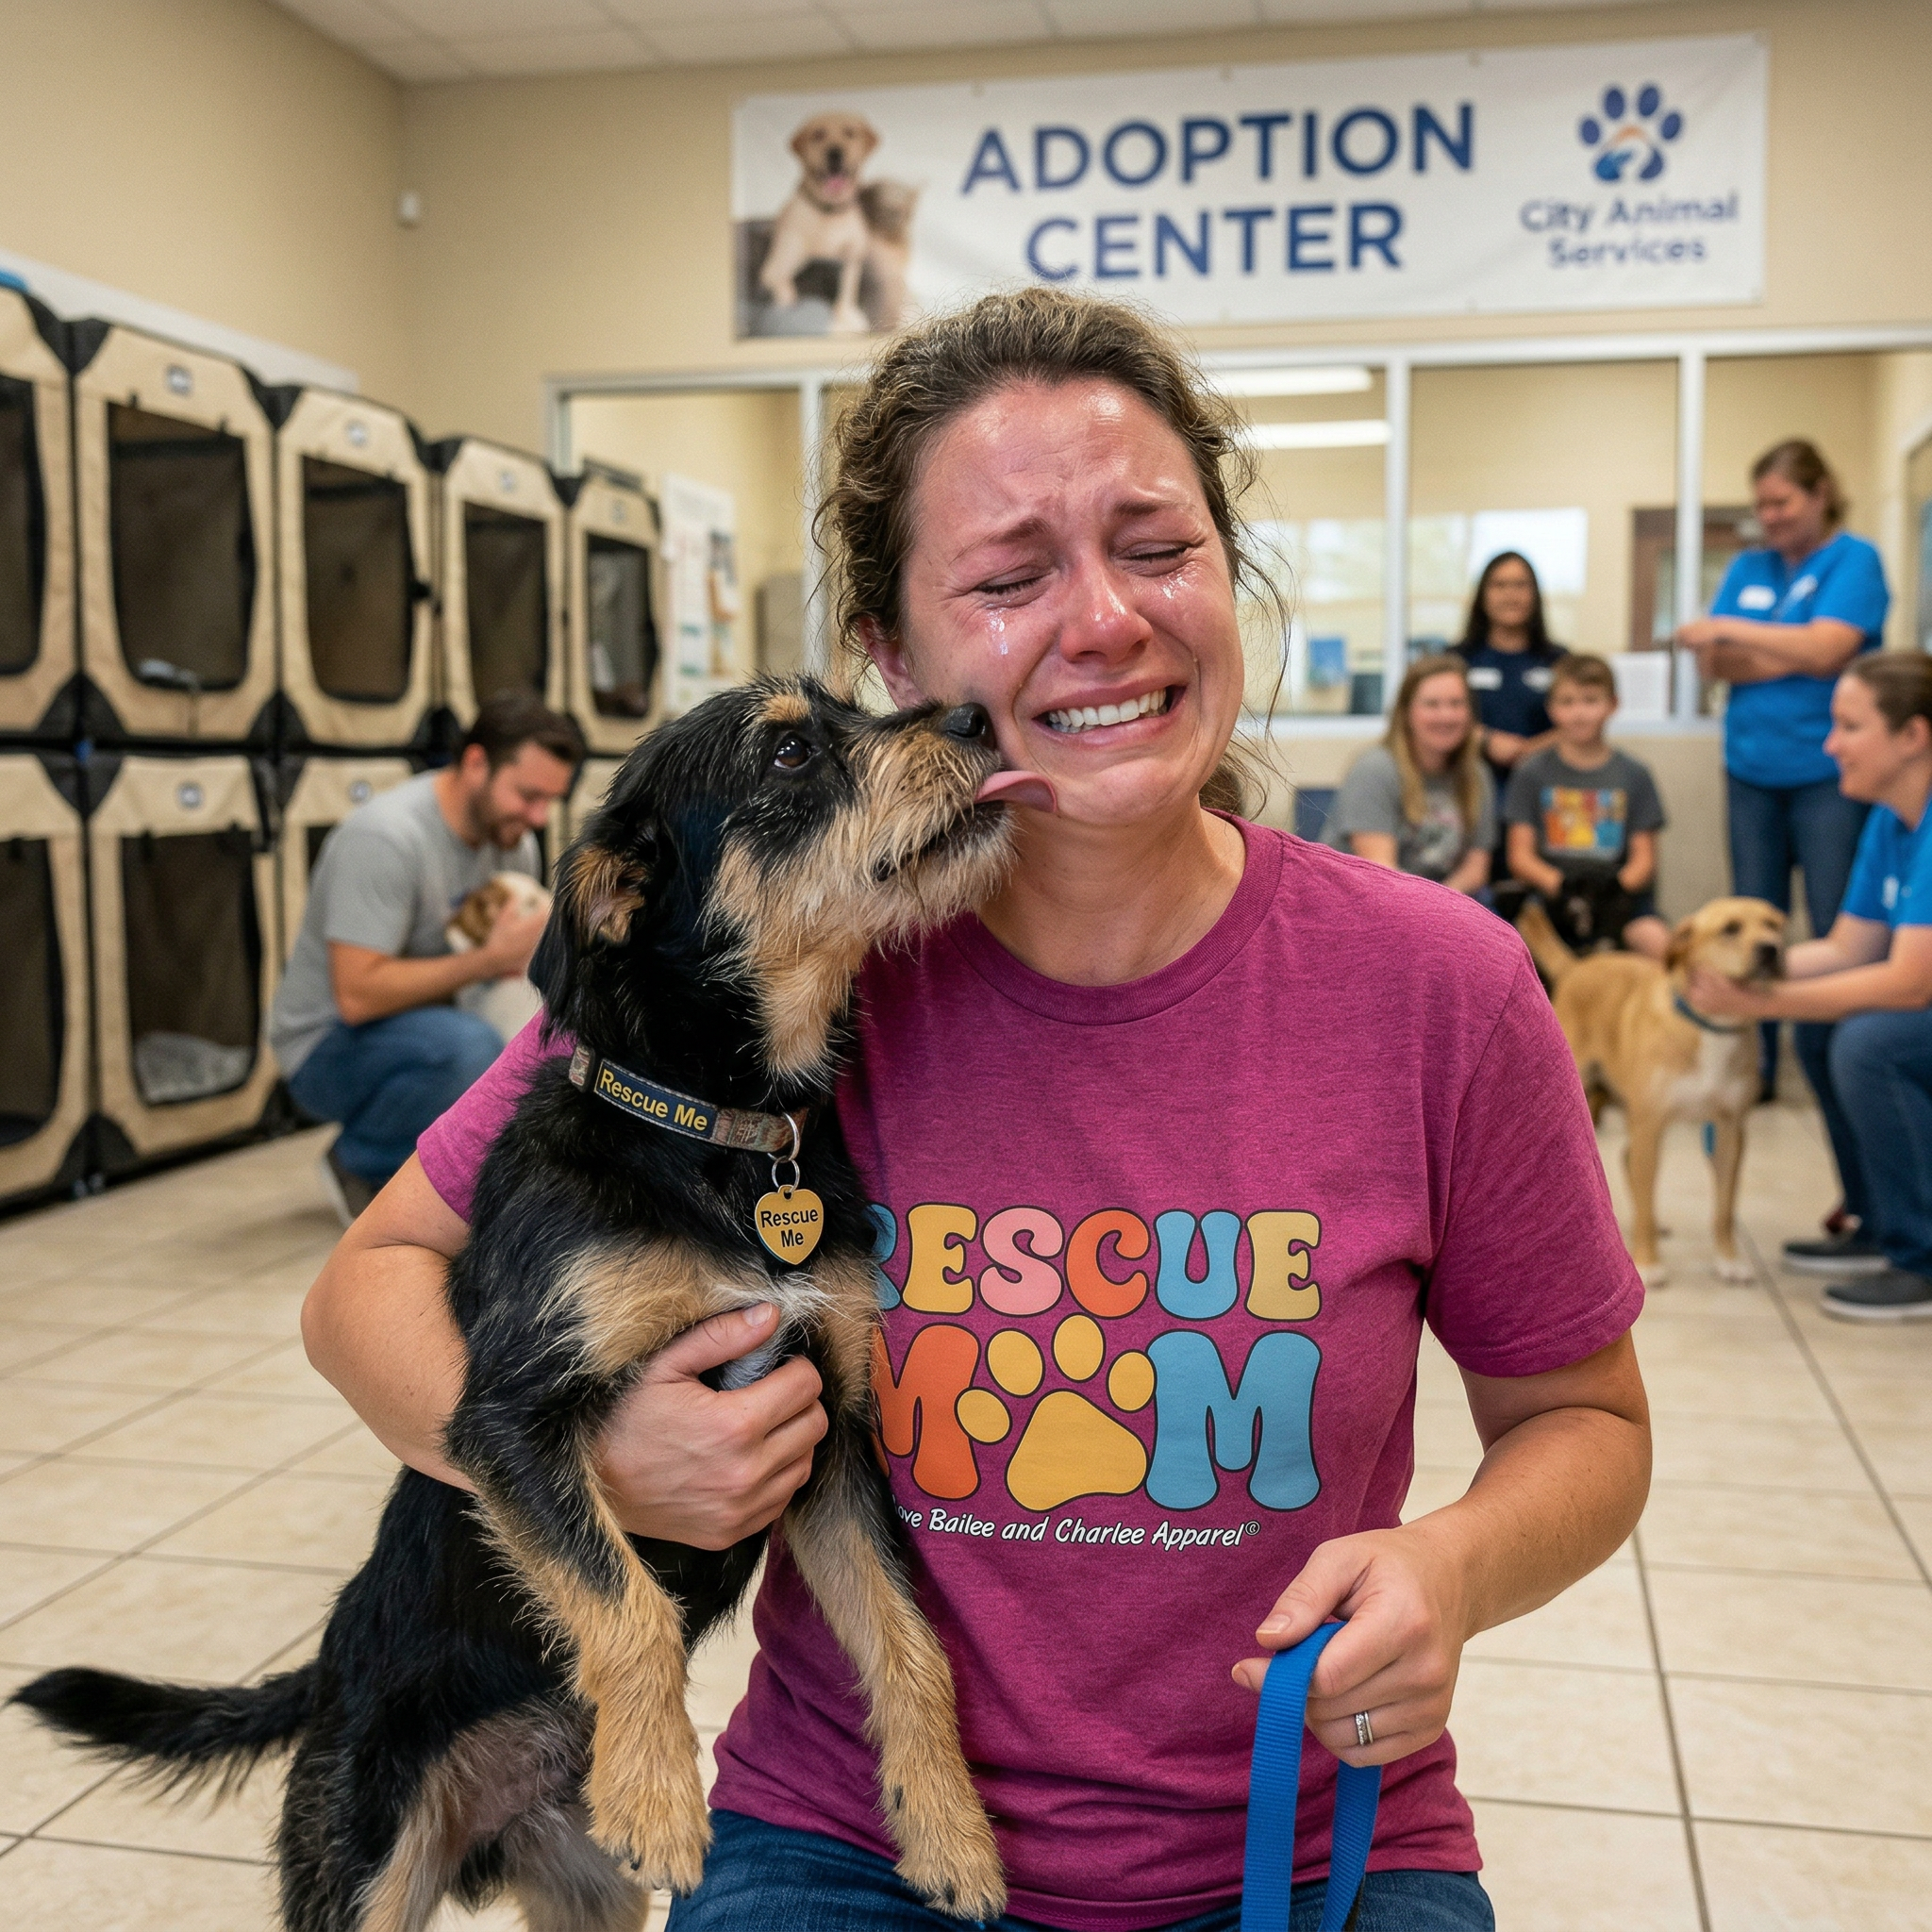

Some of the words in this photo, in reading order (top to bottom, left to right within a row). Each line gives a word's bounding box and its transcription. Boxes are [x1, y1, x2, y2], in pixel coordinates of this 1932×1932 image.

[959, 100, 1474, 196] ADOPTION
[1519, 198, 1594, 233] City
[1607, 189, 1739, 226] Animal
[1024, 199, 1406, 281] CENTER
[1548, 236, 1707, 268] Services
[600, 1068, 669, 1118] Rescue
[674, 1103, 708, 1131] Me
[760, 1208, 819, 1228] Rescue
[780, 1229, 804, 1247] Me
[928, 1507, 996, 1539] Bailee
[1000, 1515, 1050, 1542] and
[1054, 1517, 1146, 1546] Charlee
